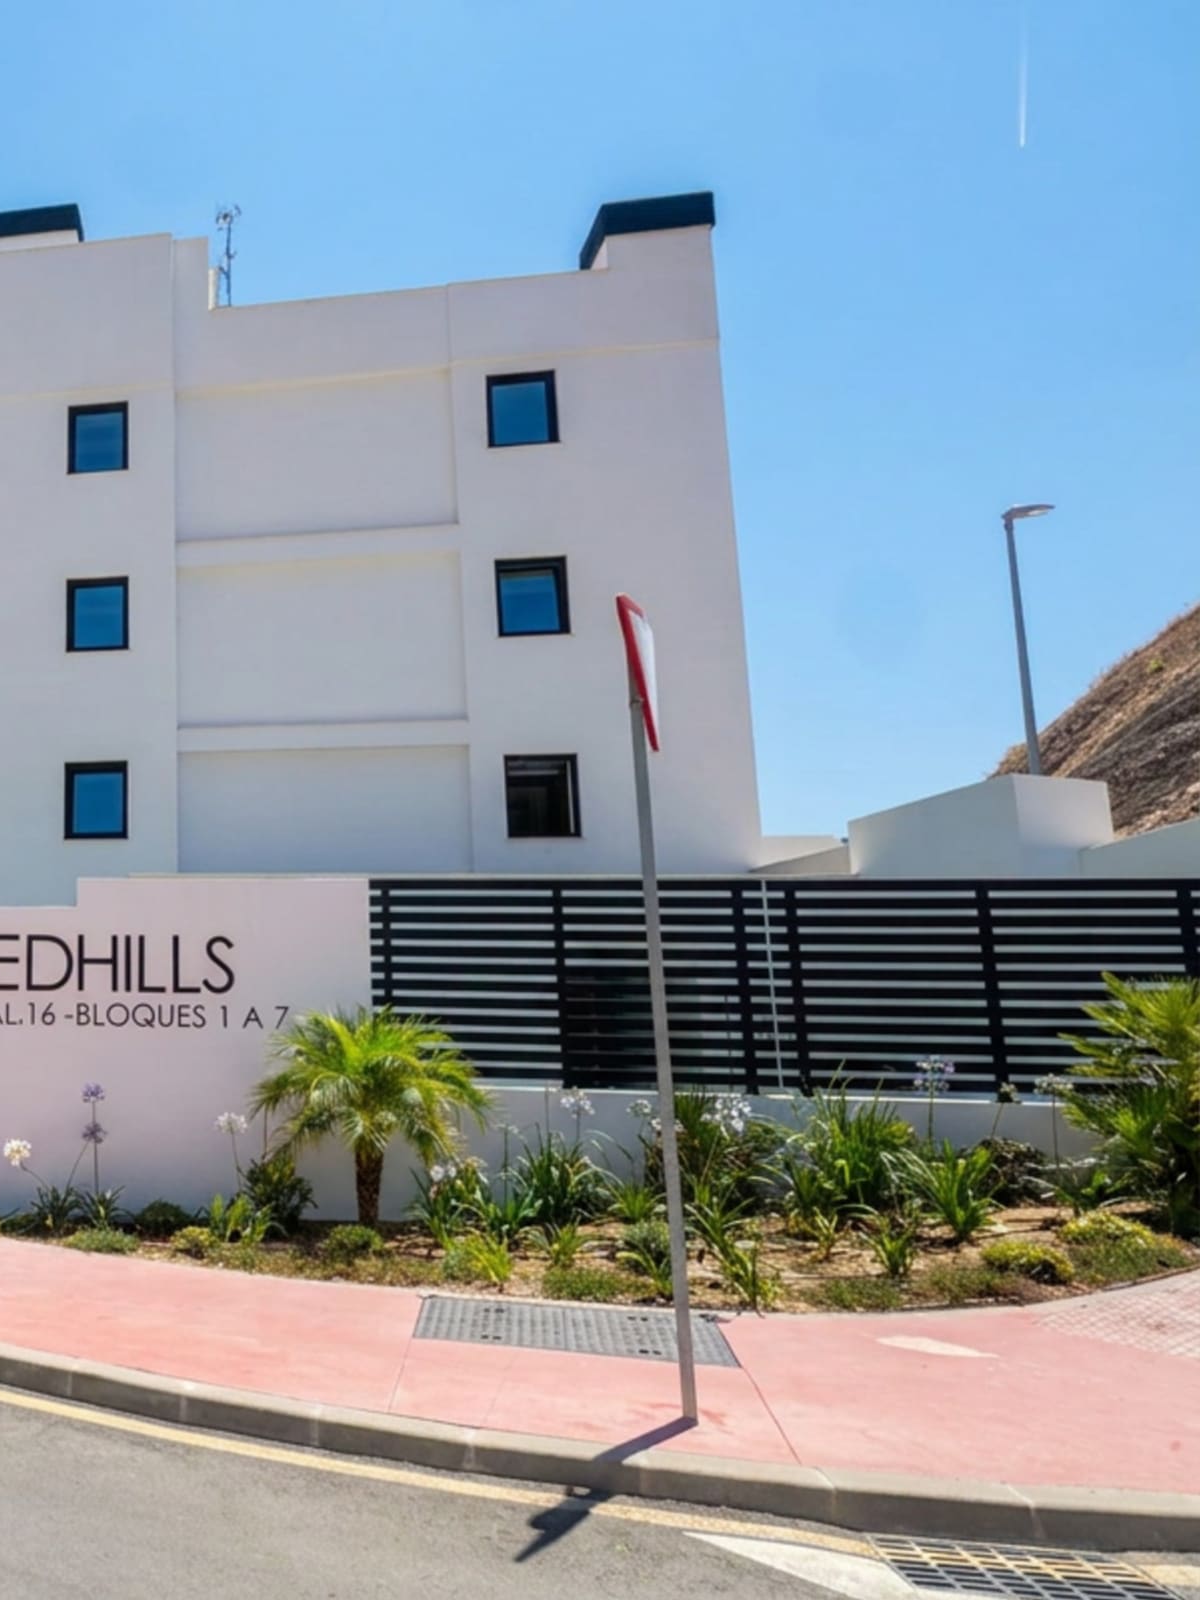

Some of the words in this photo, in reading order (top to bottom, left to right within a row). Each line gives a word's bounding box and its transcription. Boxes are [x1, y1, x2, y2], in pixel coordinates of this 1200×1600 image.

[220, 1004, 229, 1029] 1
[242, 1006, 264, 1030] A
[274, 1005, 290, 1030] 7
